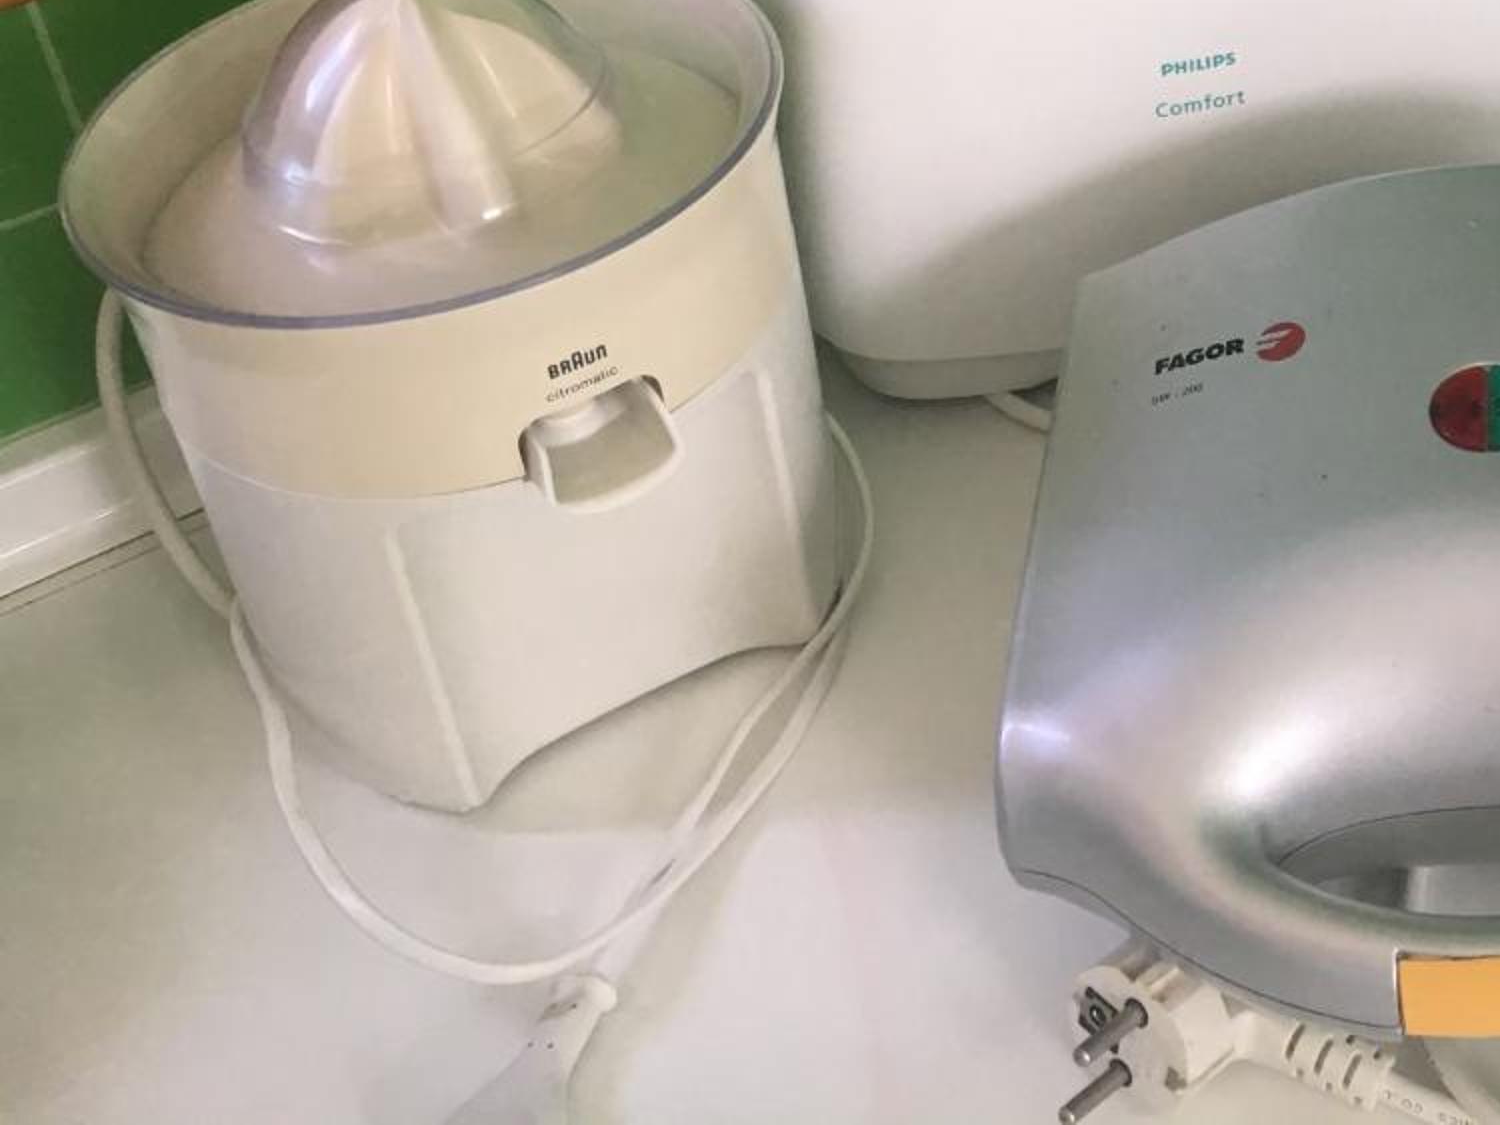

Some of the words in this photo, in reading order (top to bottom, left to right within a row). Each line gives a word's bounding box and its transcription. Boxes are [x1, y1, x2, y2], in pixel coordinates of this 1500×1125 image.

[1160, 52, 1237, 77] PHILIPS
[1154, 90, 1247, 118] Comfort
[547, 343, 609, 379] BRAUN
[1154, 338, 1245, 376] FAGOR
[545, 365, 619, 403] citromatic
